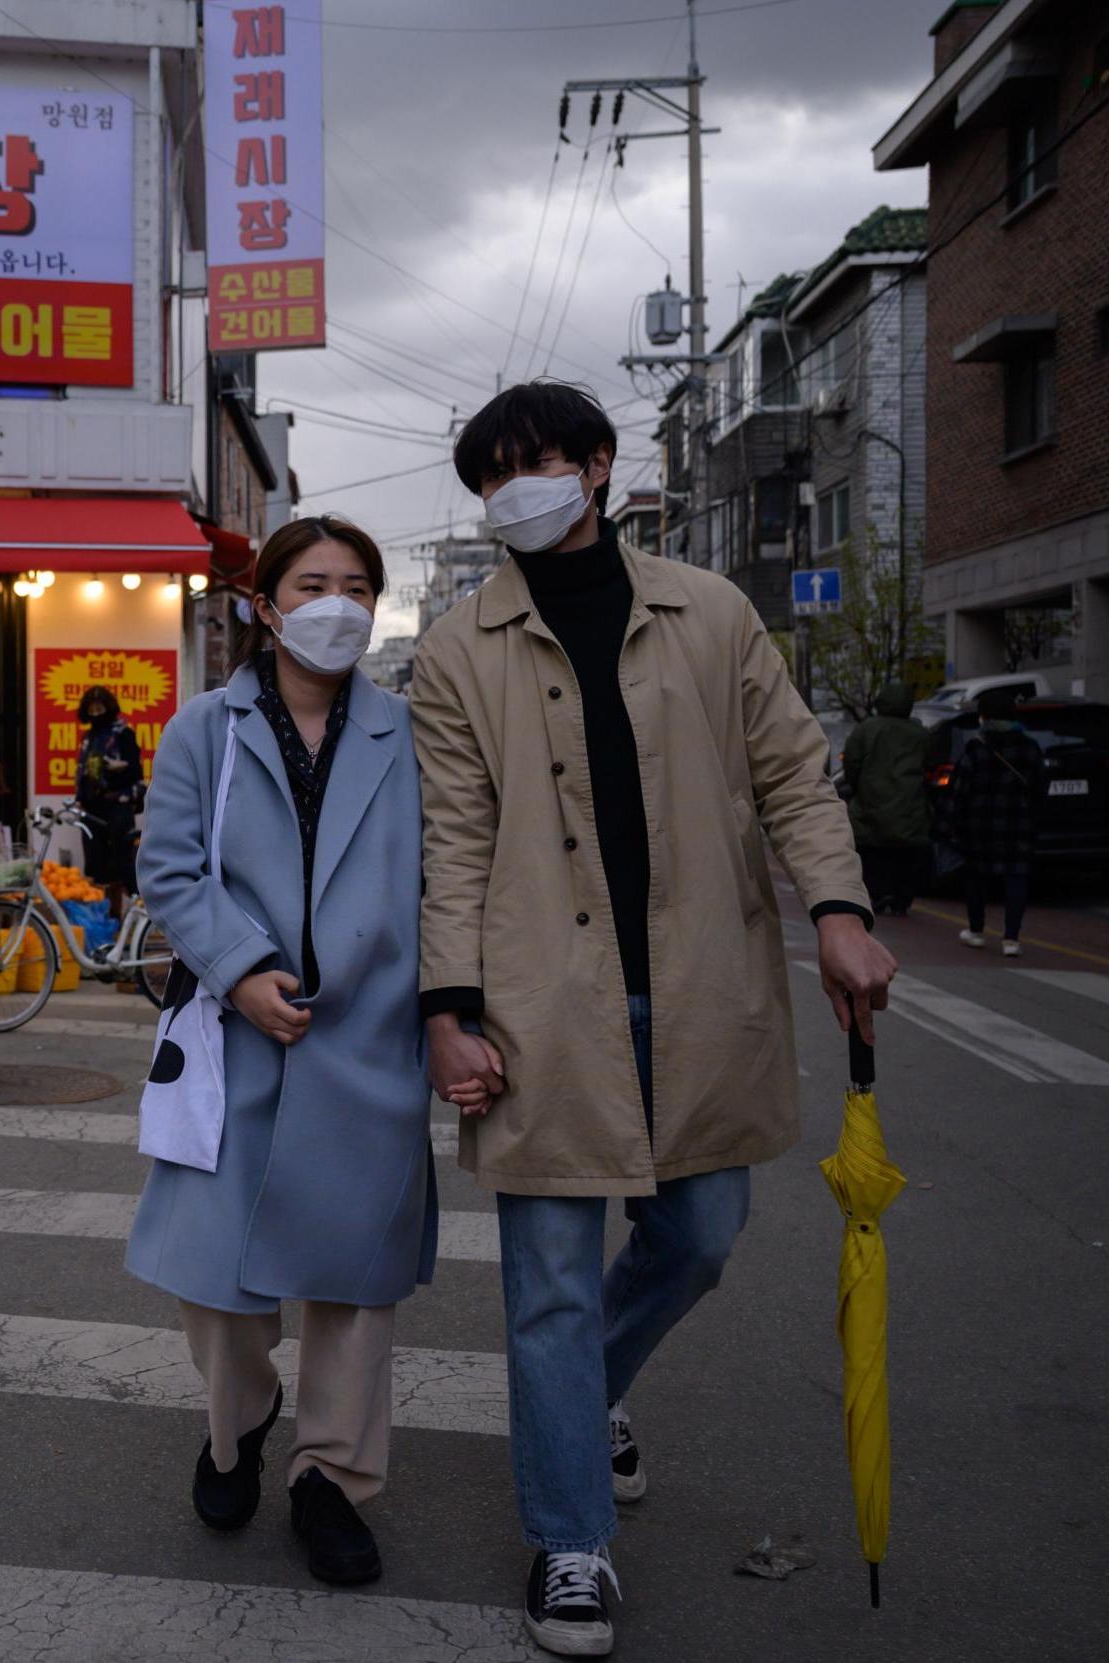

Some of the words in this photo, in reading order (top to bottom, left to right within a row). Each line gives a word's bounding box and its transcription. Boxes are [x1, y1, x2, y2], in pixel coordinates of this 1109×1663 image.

[41, 101, 114, 131] 망원점
[219, 266, 316, 302] 수산물
[219, 305, 316, 341] 건어물
